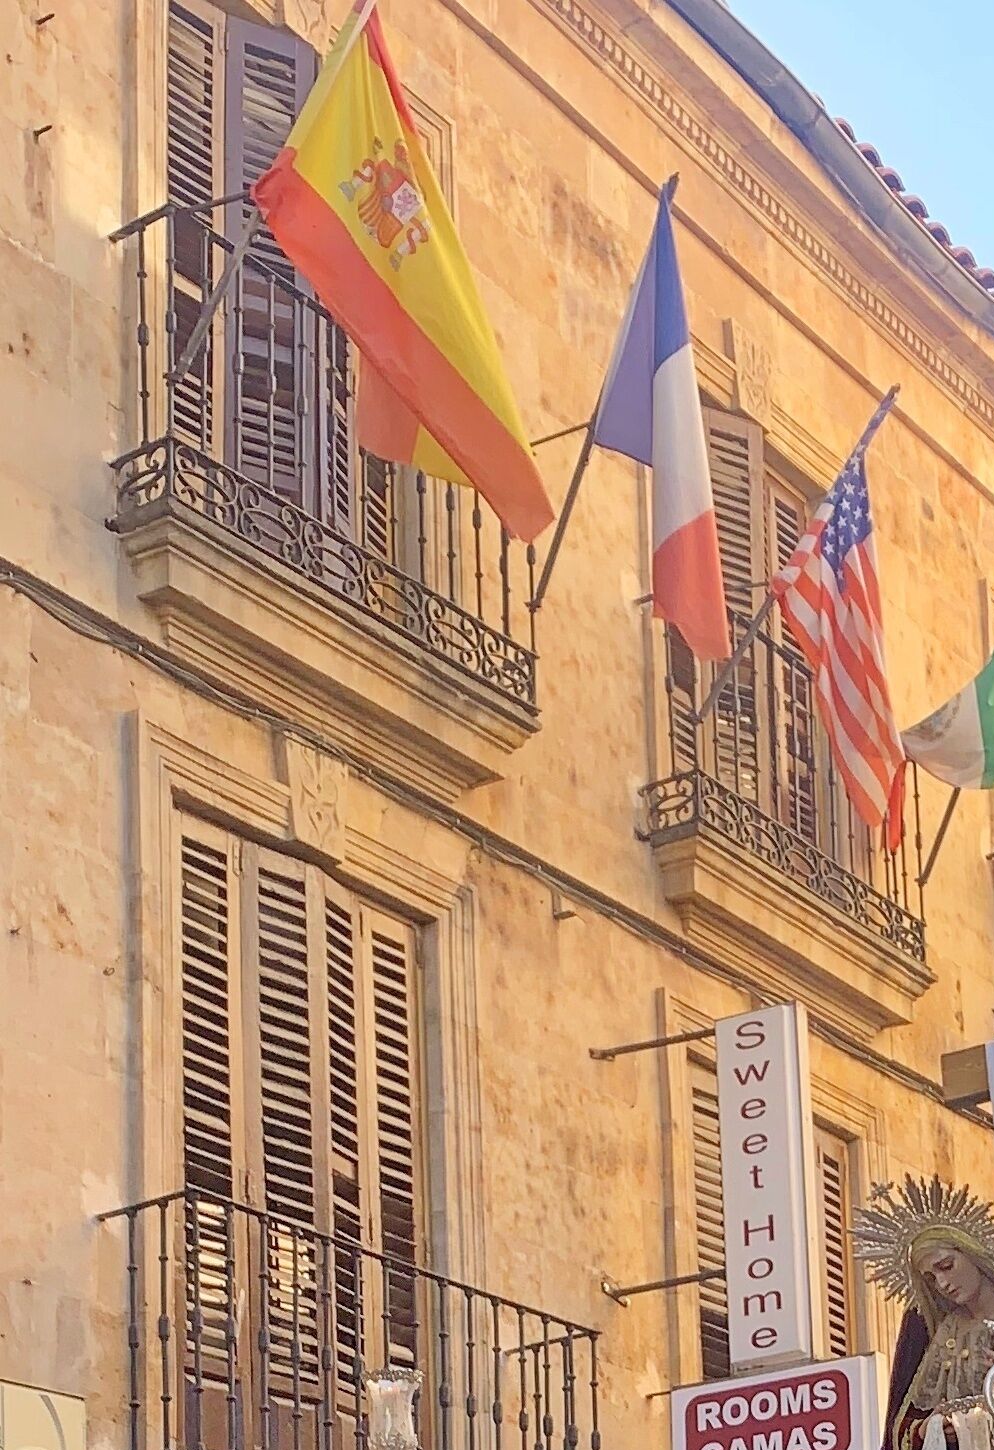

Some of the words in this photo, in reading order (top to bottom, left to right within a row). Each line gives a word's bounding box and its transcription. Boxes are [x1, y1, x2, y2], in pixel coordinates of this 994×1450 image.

[733, 1020, 770, 1190] Sweet
[743, 1214, 782, 1349] Home
[696, 1379, 838, 1432] ROOMS
